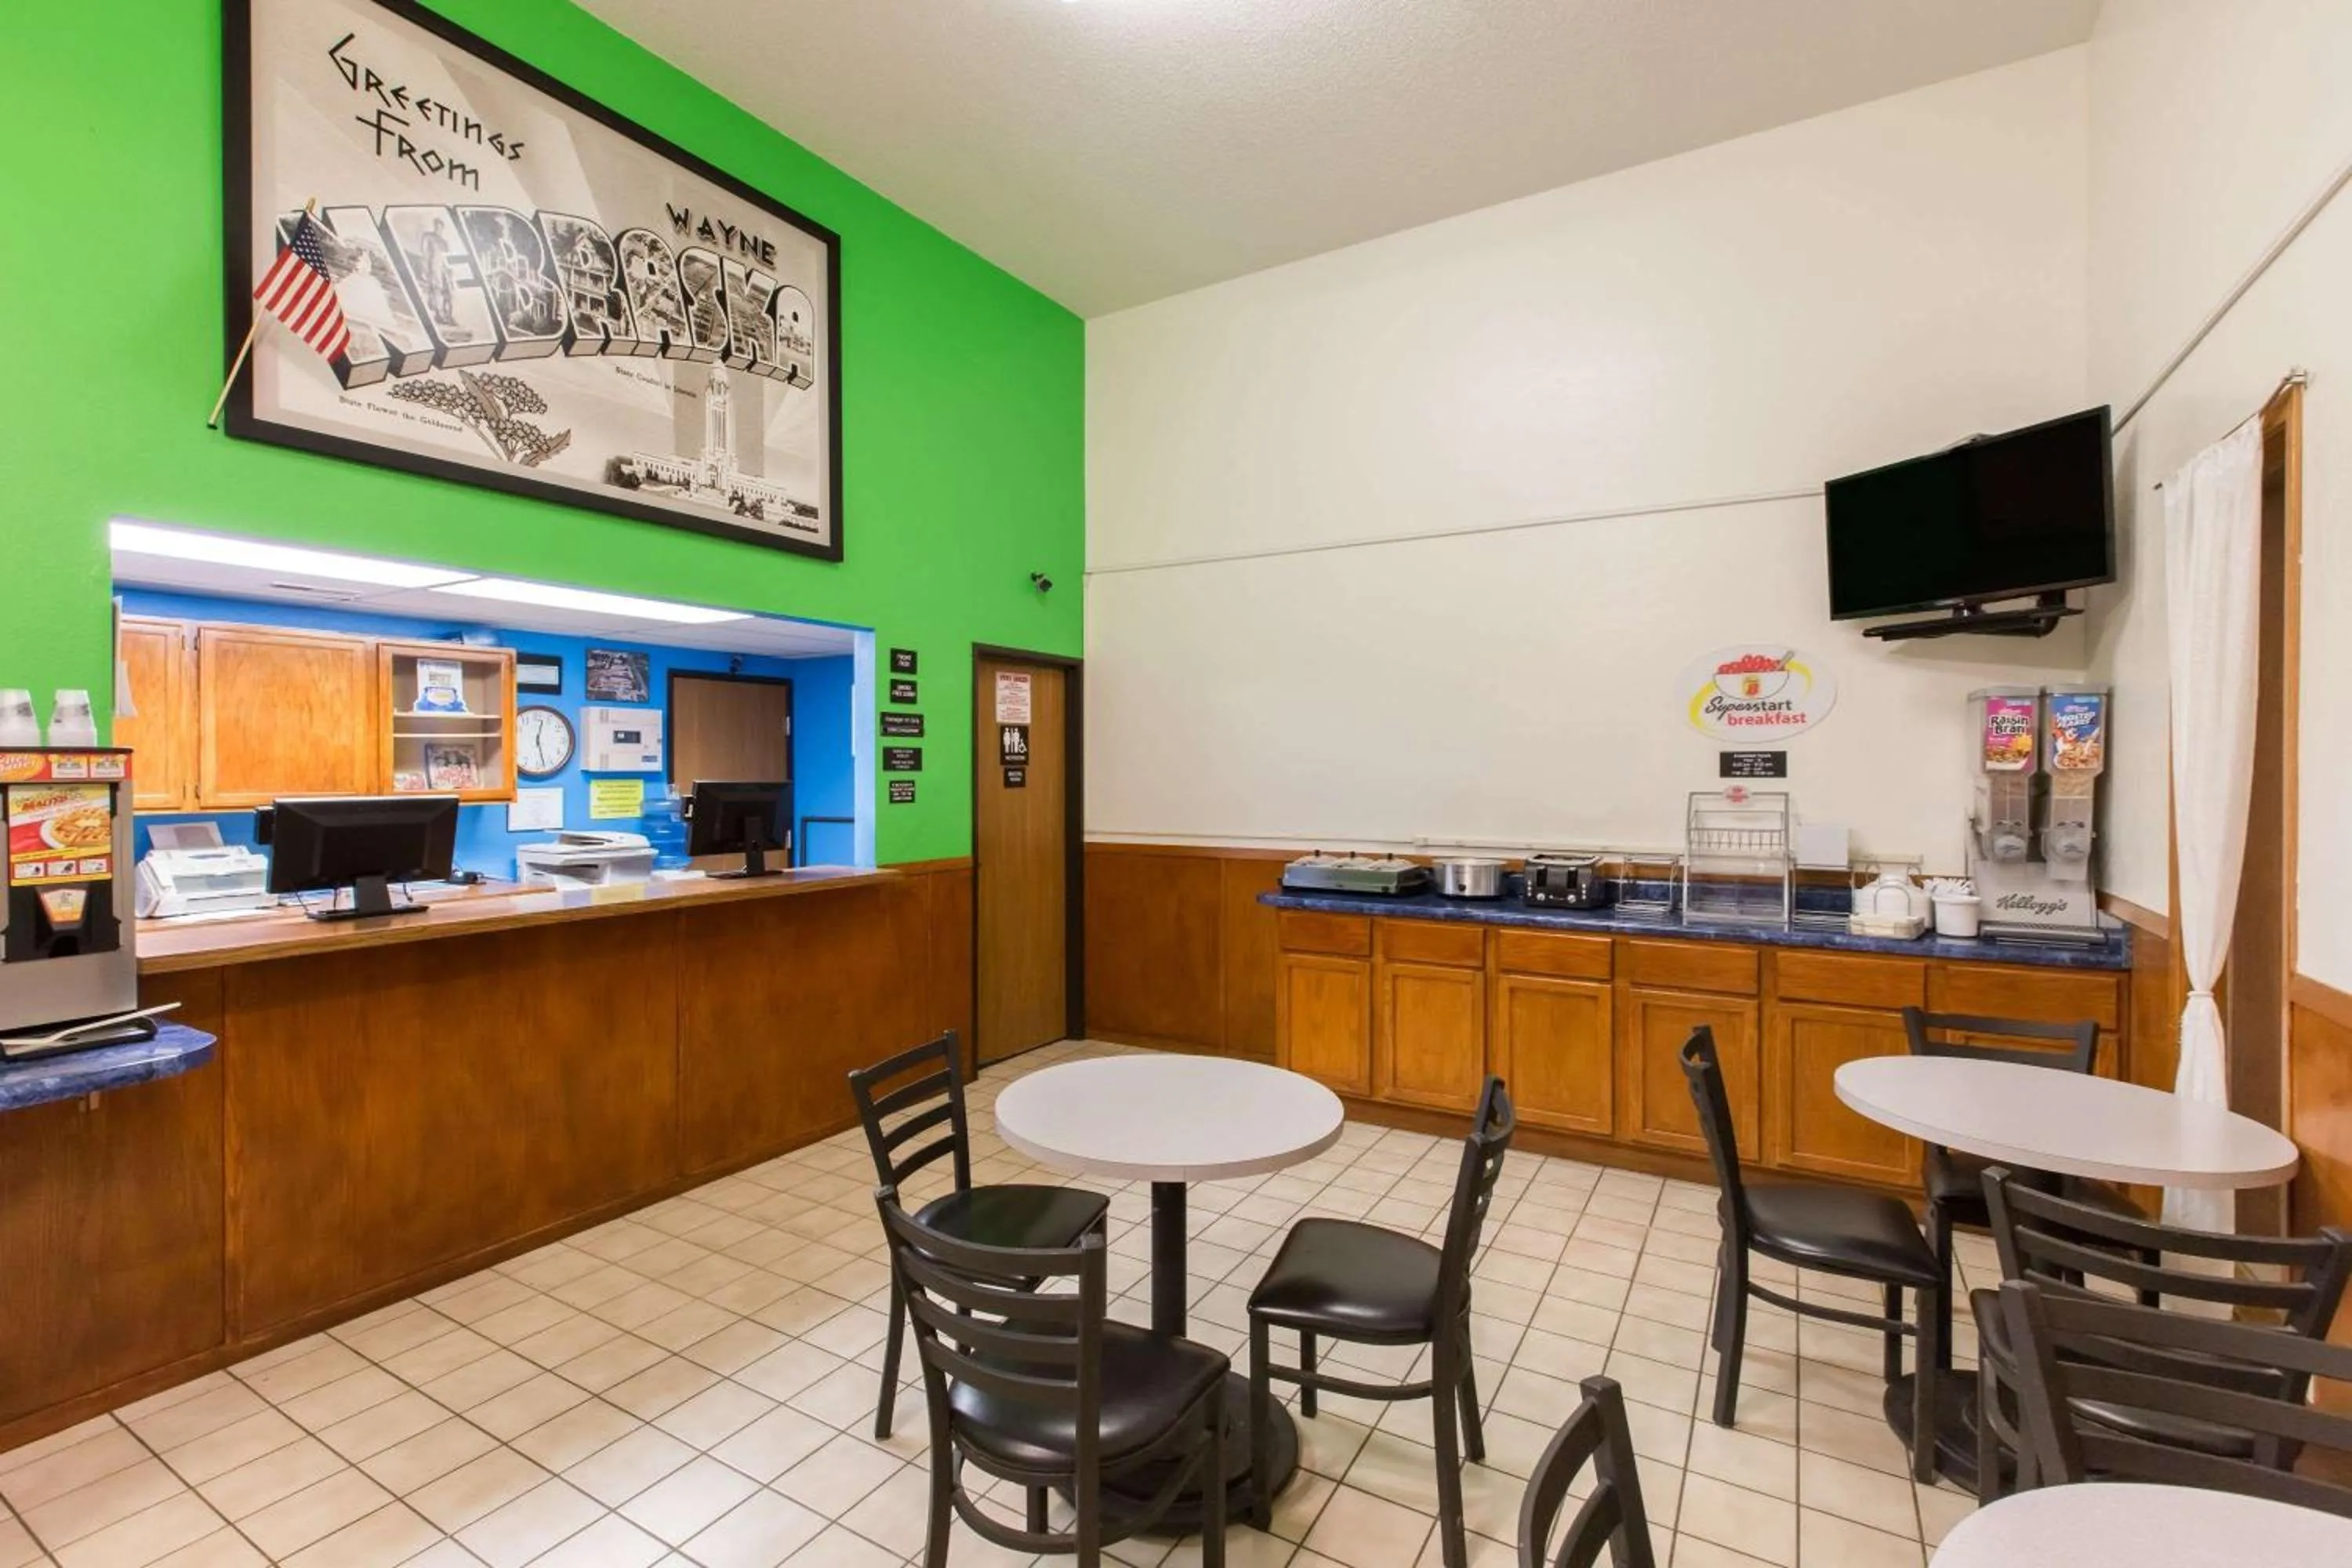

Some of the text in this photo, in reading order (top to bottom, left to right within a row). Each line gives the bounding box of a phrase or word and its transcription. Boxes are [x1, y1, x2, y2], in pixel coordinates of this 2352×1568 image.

[666, 201, 778, 272] WAYNE
[1727, 713, 1807, 727] breakfast
[1990, 715, 2029, 727] Raisin
[1994, 724, 2026, 735] Bran
[1996, 893, 2068, 916] Kellogg's
